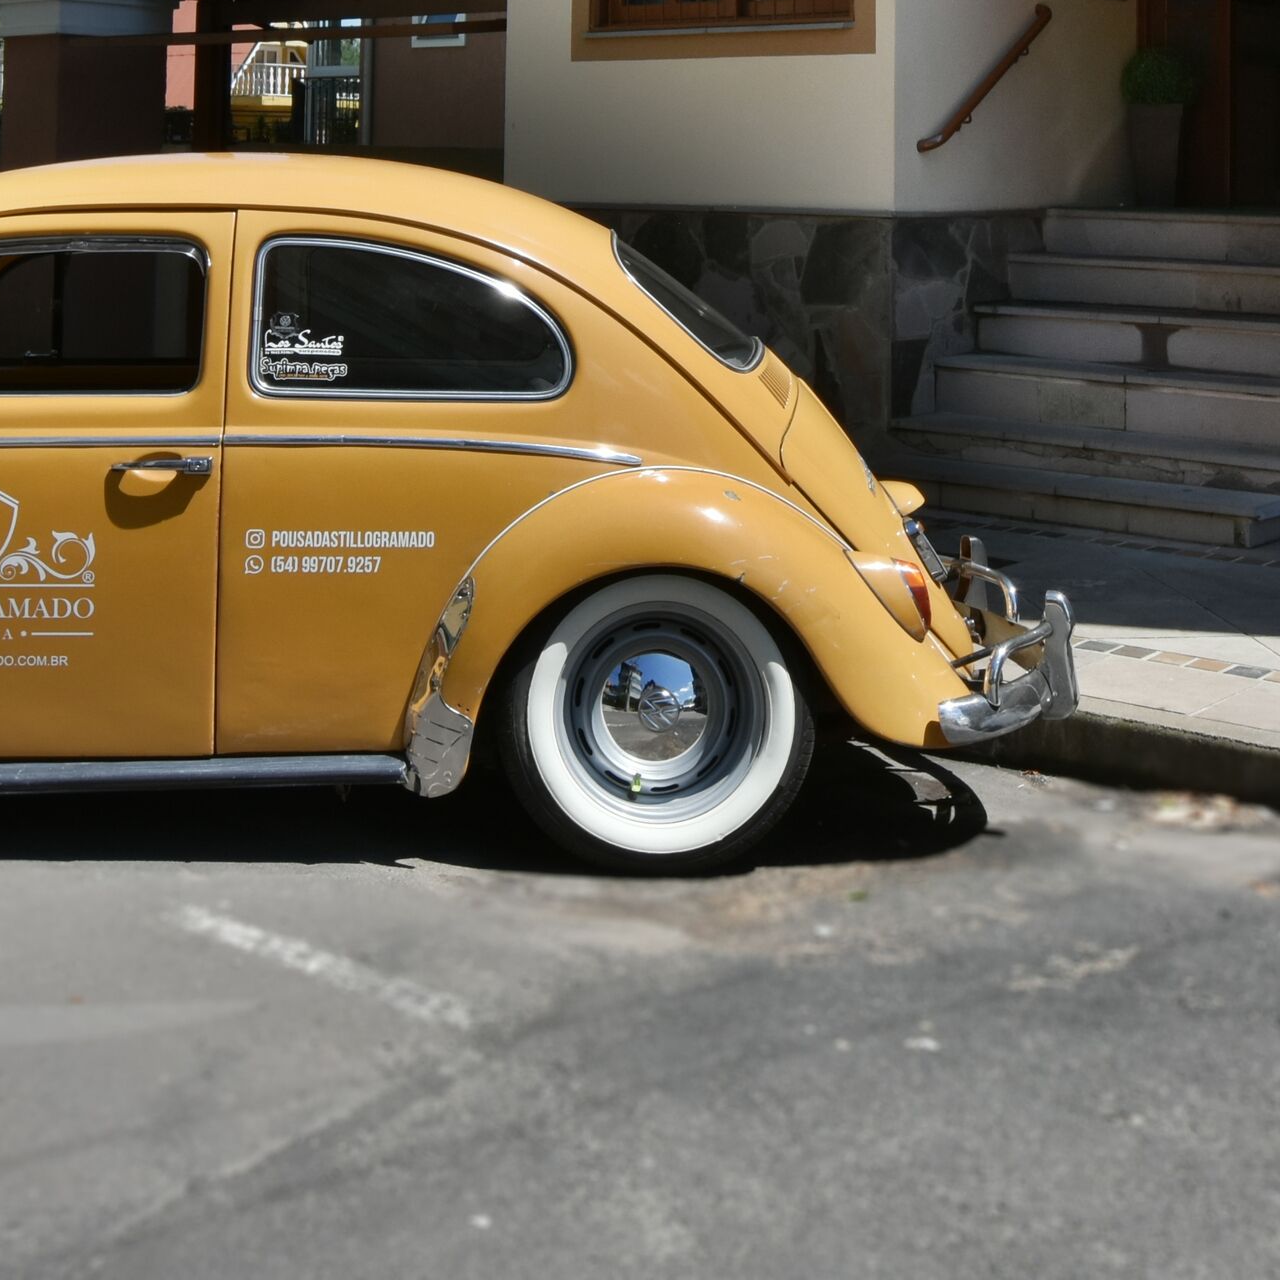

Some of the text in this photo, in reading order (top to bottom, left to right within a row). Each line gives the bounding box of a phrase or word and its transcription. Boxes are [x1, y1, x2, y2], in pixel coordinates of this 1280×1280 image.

[271, 531, 435, 548] POUSADASTILLOGRAMADO
[271, 556, 381, 574] (54) 99707.9257
